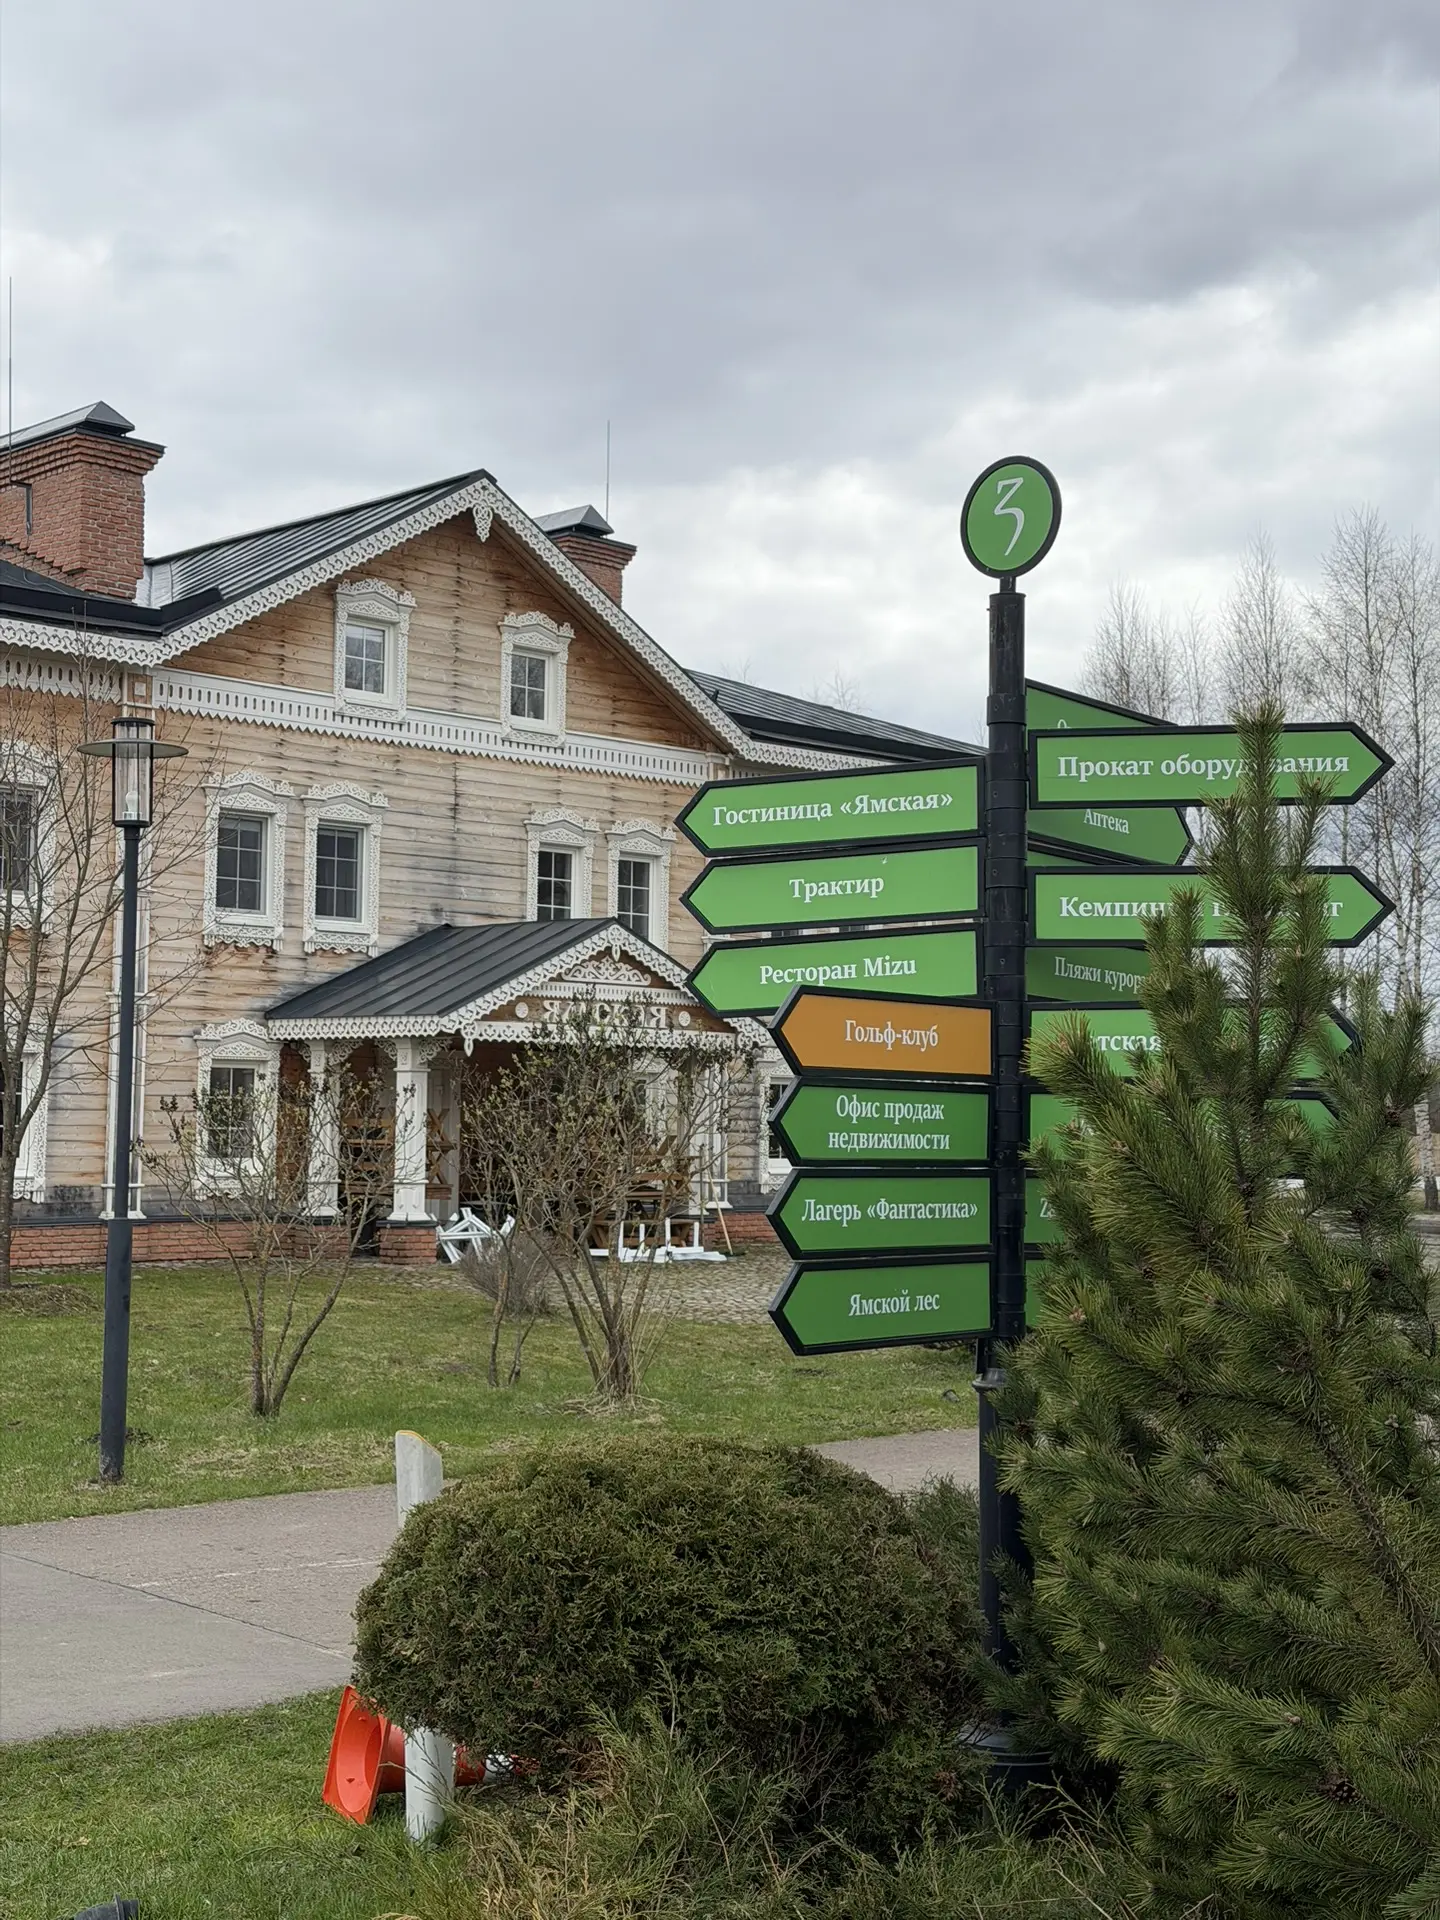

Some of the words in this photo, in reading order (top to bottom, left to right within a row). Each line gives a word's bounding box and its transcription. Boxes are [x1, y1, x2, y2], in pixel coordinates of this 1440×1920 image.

[994, 476, 1025, 556] 3
[1057, 756, 1154, 783] Прокат
[713, 801, 833, 826] Гостиница
[840, 793, 953, 815] «Ямская»
[1083, 808, 1130, 834] Аптека
[789, 876, 885, 903] Трактир
[1059, 896, 1174, 917] Кемпин
[759, 963, 857, 985] Ресторан
[863, 955, 917, 978] Mizu
[1055, 956, 1101, 982] Пляжи
[1104, 969, 1147, 994] курор
[845, 1019, 939, 1052] Гольф-клуб
[836, 1094, 880, 1124] Офис
[884, 1101, 945, 1124] продаж
[828, 1132, 950, 1152] недвижимости
[802, 1199, 862, 1227] Лагерь
[867, 1198, 978, 1220] «Фантастика»
[849, 1289, 910, 1316] Ямской
[914, 1293, 940, 1311] лес
